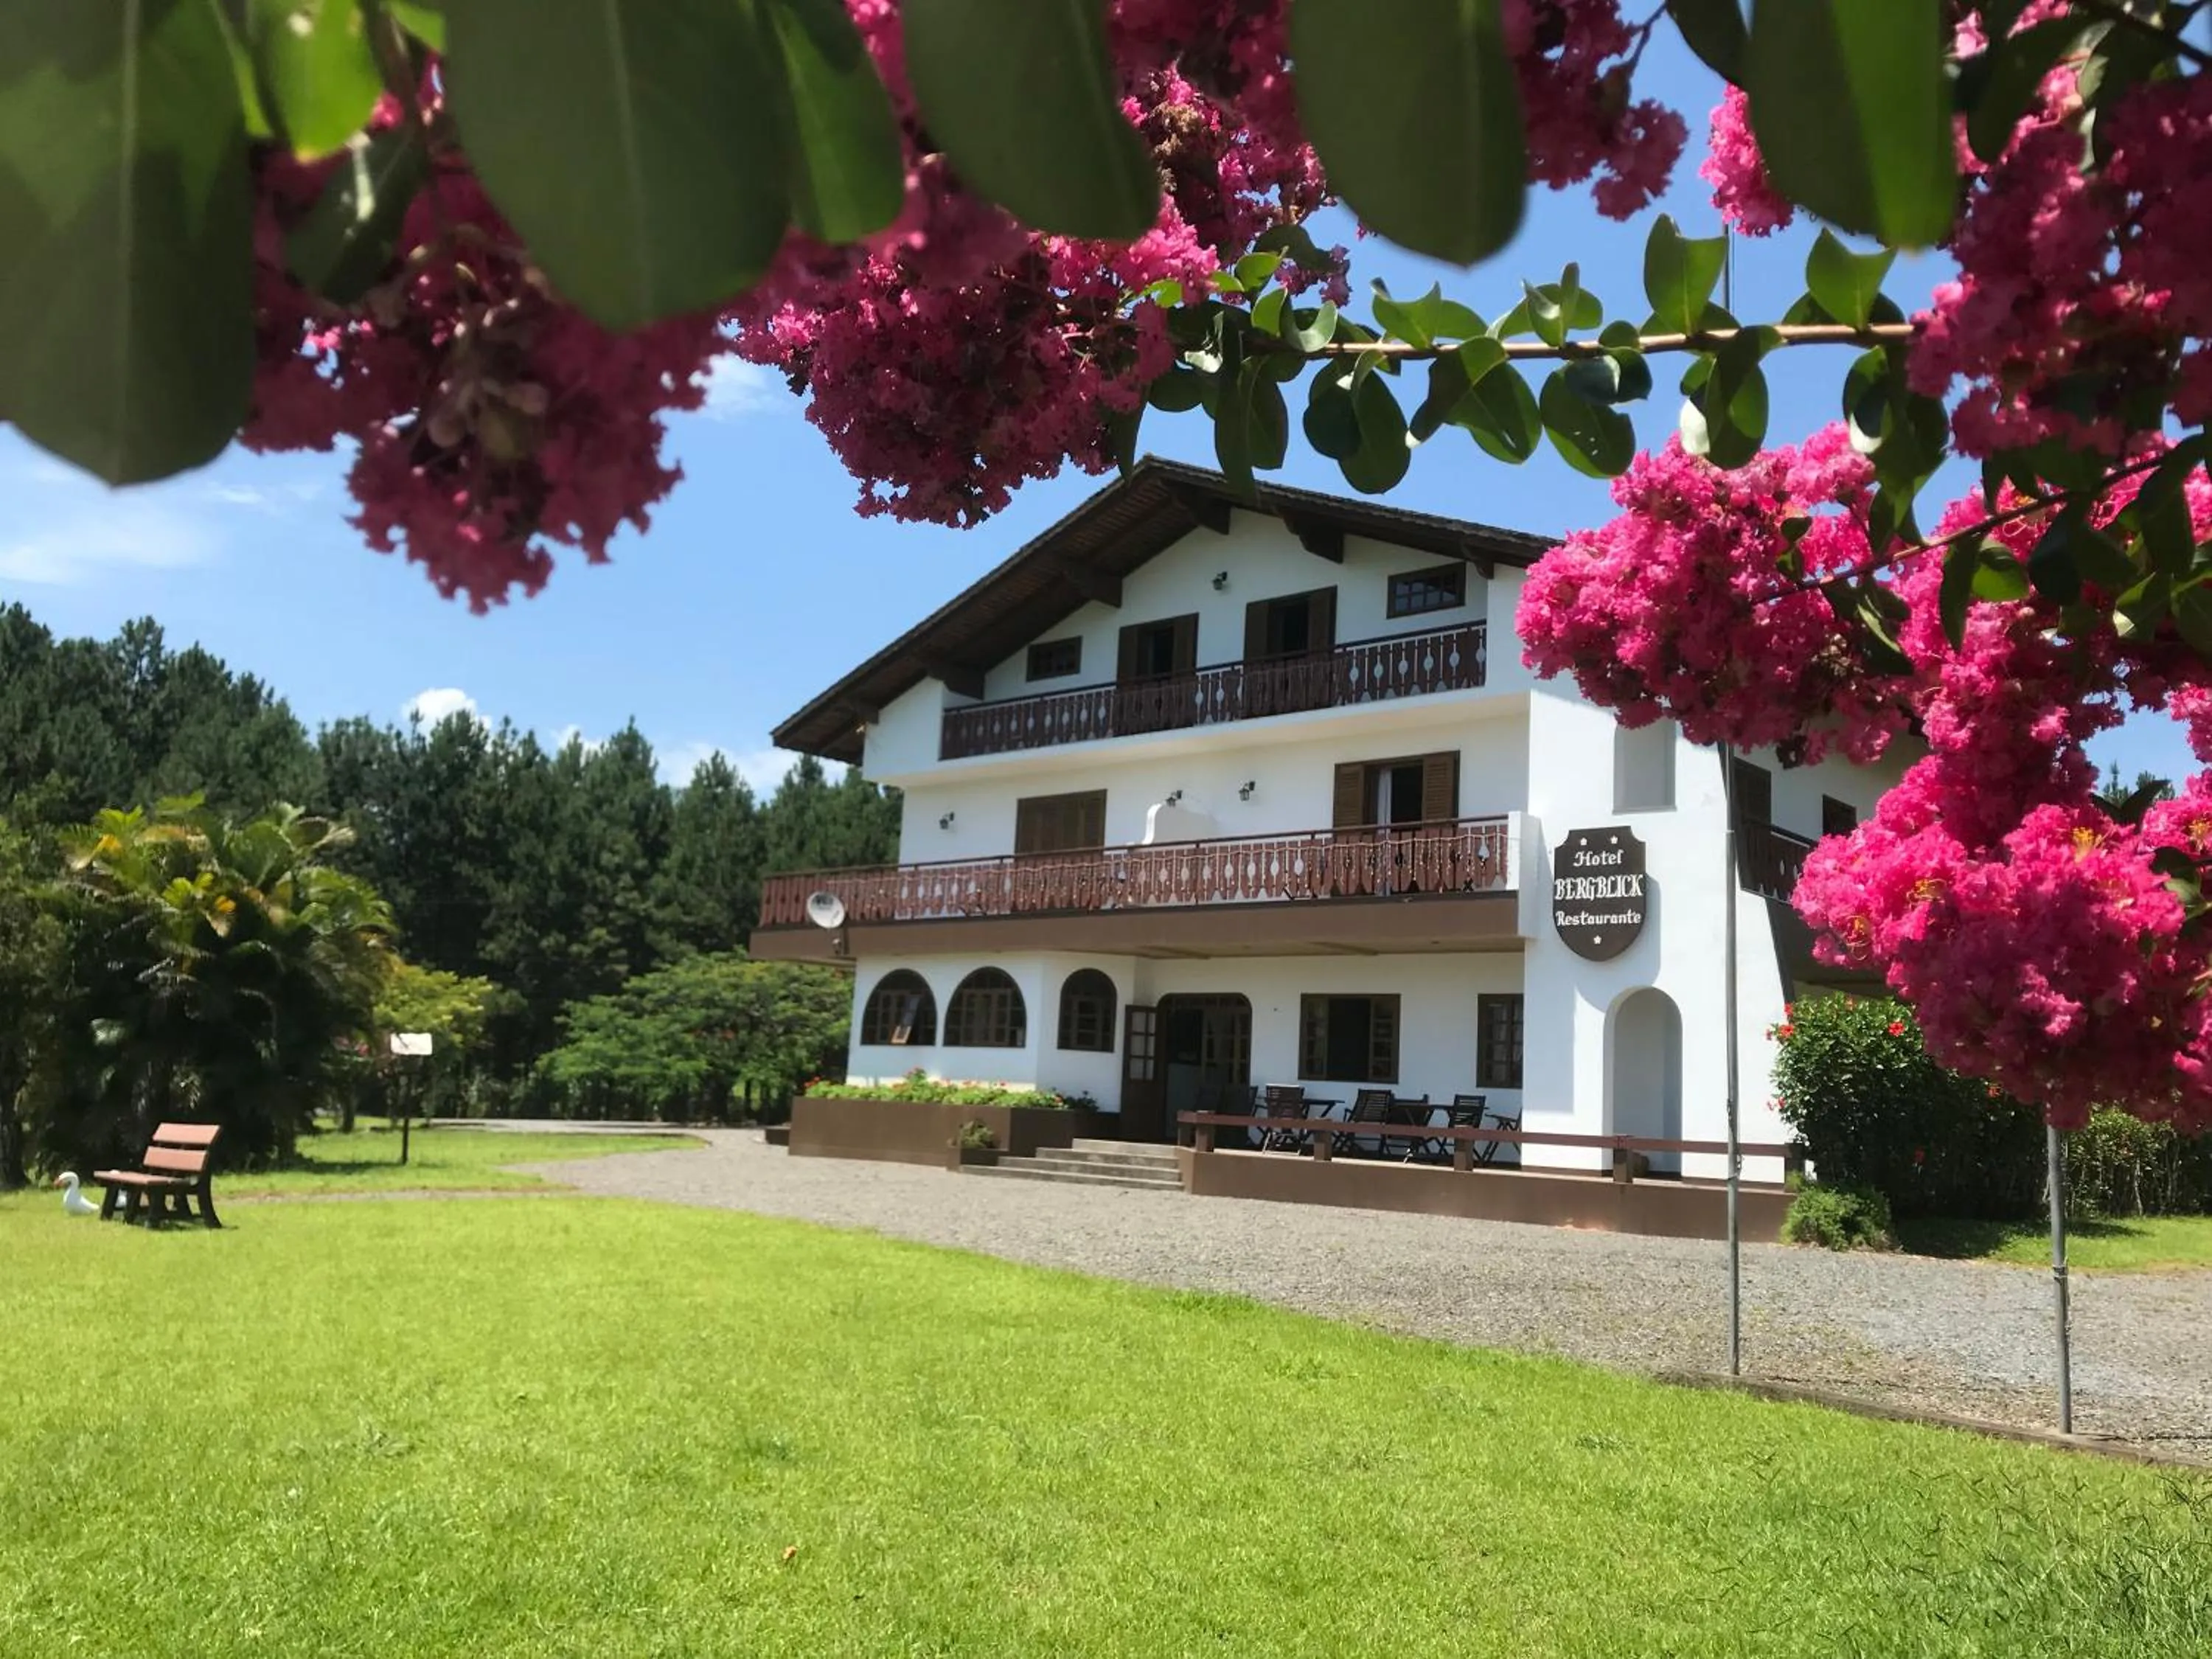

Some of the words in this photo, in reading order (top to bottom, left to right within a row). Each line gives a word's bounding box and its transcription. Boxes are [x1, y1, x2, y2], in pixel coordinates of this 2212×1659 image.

[1573, 849, 1624, 866] Hotel
[1555, 874, 1643, 901] BERGBLICK
[1556, 908, 1641, 926] Restaurante
